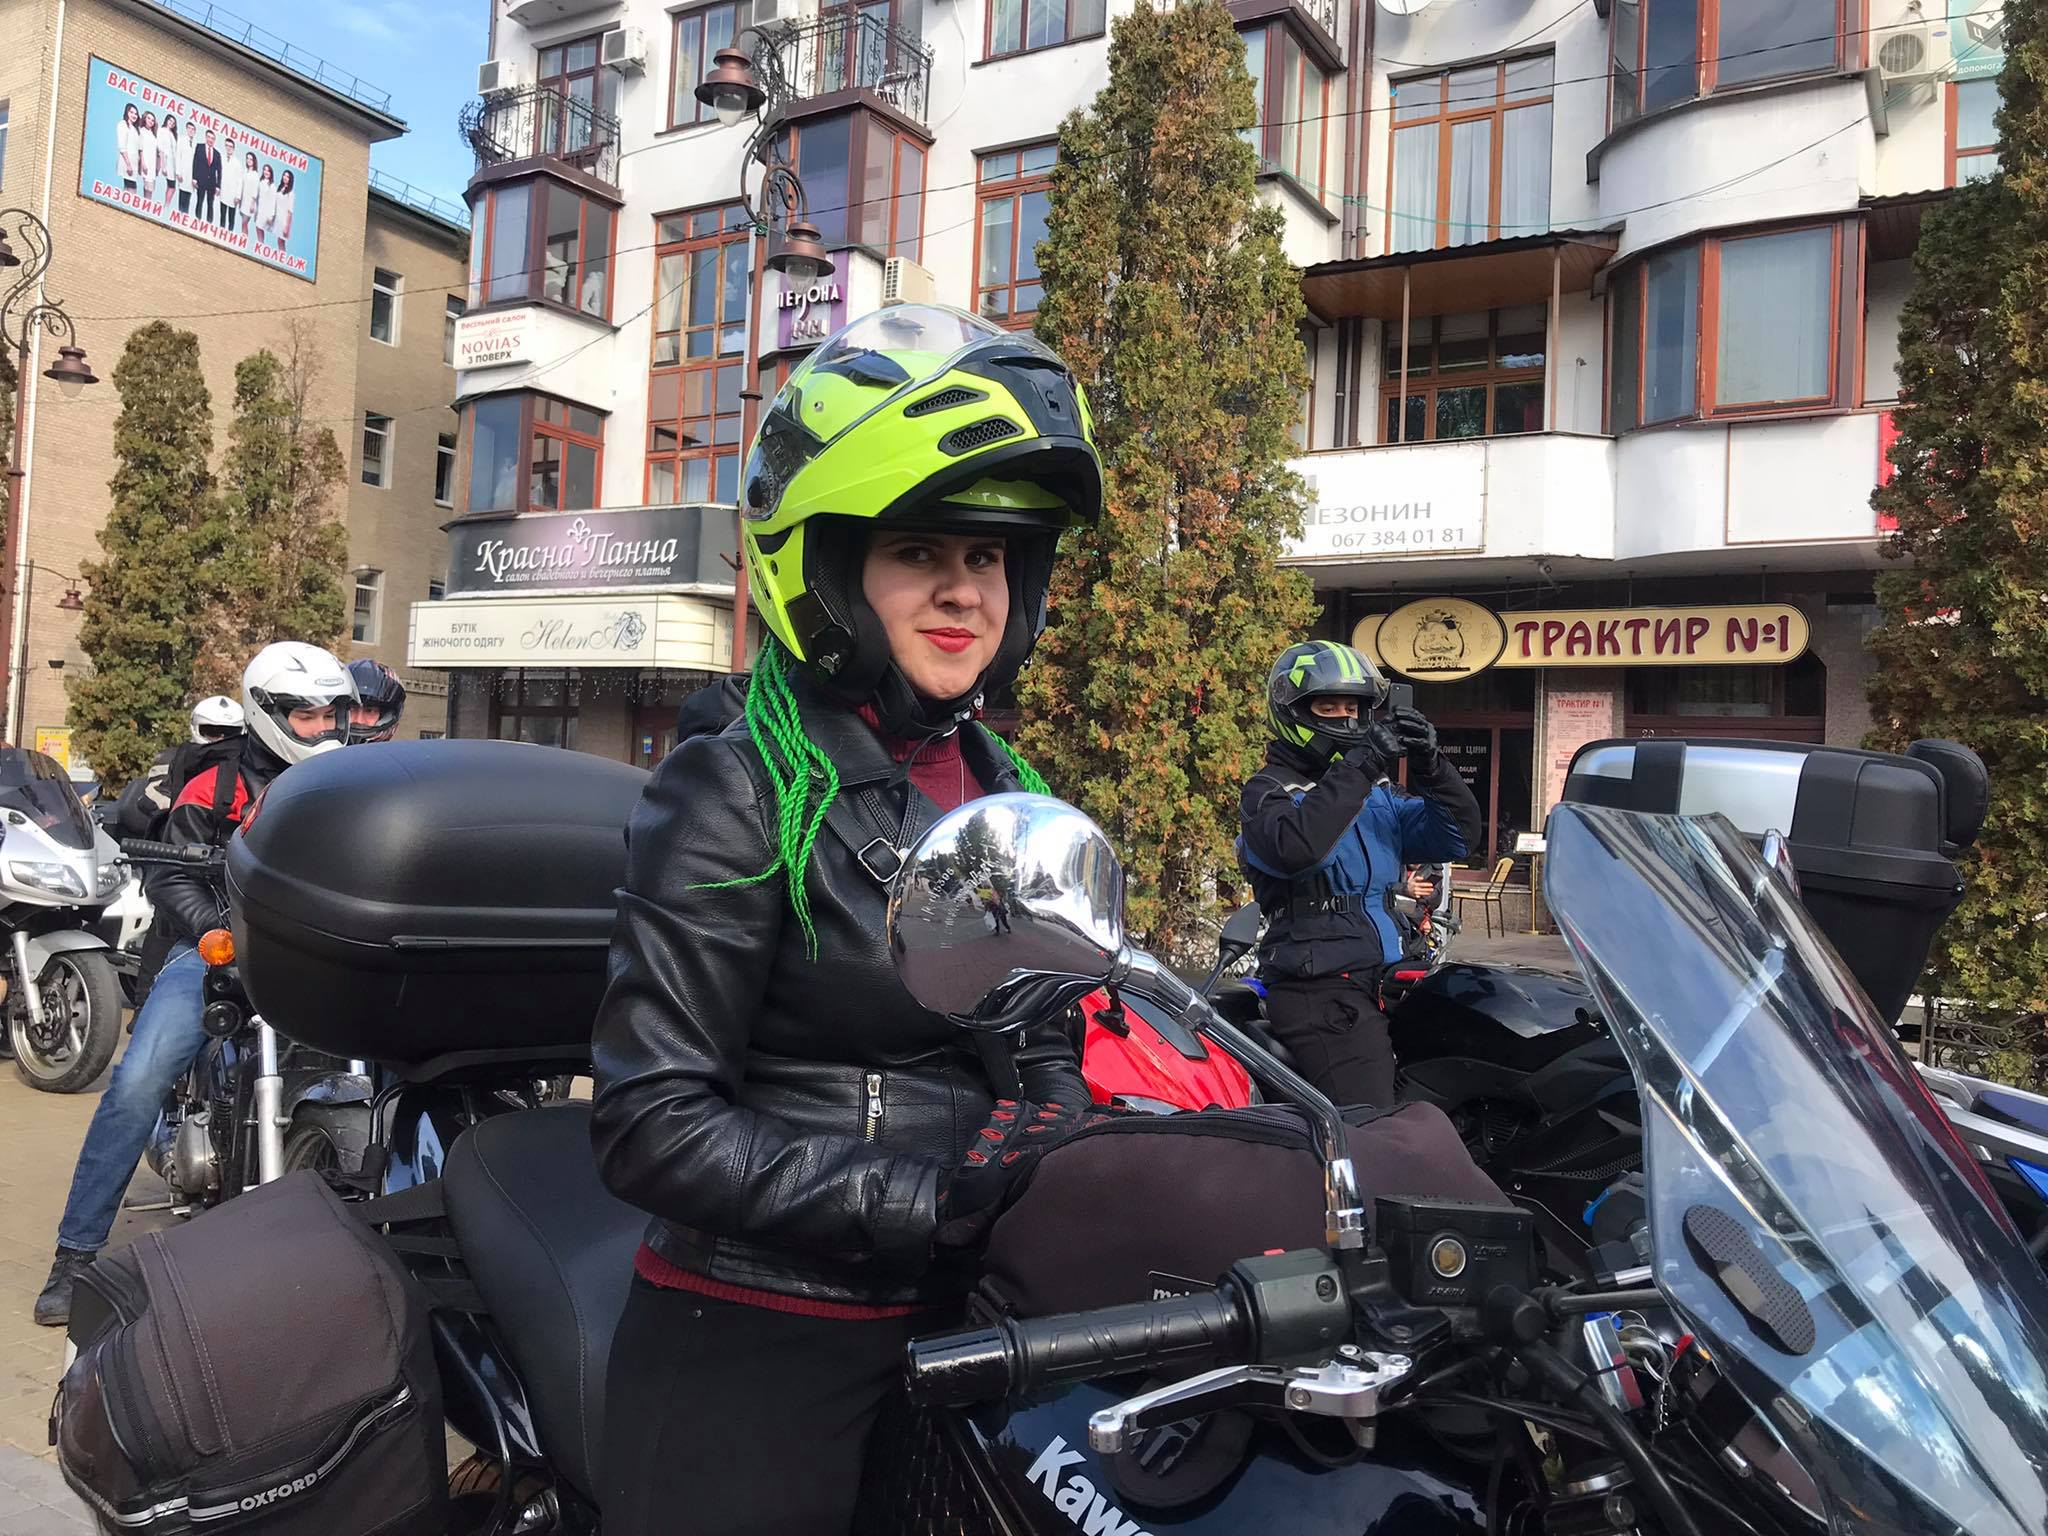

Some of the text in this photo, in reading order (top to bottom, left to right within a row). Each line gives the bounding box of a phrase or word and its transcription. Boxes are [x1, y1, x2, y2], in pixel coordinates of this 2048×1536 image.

[107, 71, 309, 171] ВАС ВІТАЄ ХМЕЛЬНИЦЬКИЙ
[92, 181, 306, 271] БАЗОВИЙ МЕДИЧНИЙ КОЛЕДЖ
[461, 335, 521, 355] NOVIAS
[476, 351, 512, 363] ПОВЕРХ
[1332, 528, 1464, 548] 067 384 01 81
[475, 532, 679, 582] Красна Панна
[505, 573, 530, 582] салон
[635, 566, 672, 577] платья
[451, 623, 478, 633] БУТІК
[1514, 615, 1790, 656] ТРАКТИР №1
[423, 637, 505, 648] ЖІНОЧОГО ОДЯГУ
[1557, 699, 1591, 708] ТРАКТИР
[240, 1472, 319, 1511] OXFORD
